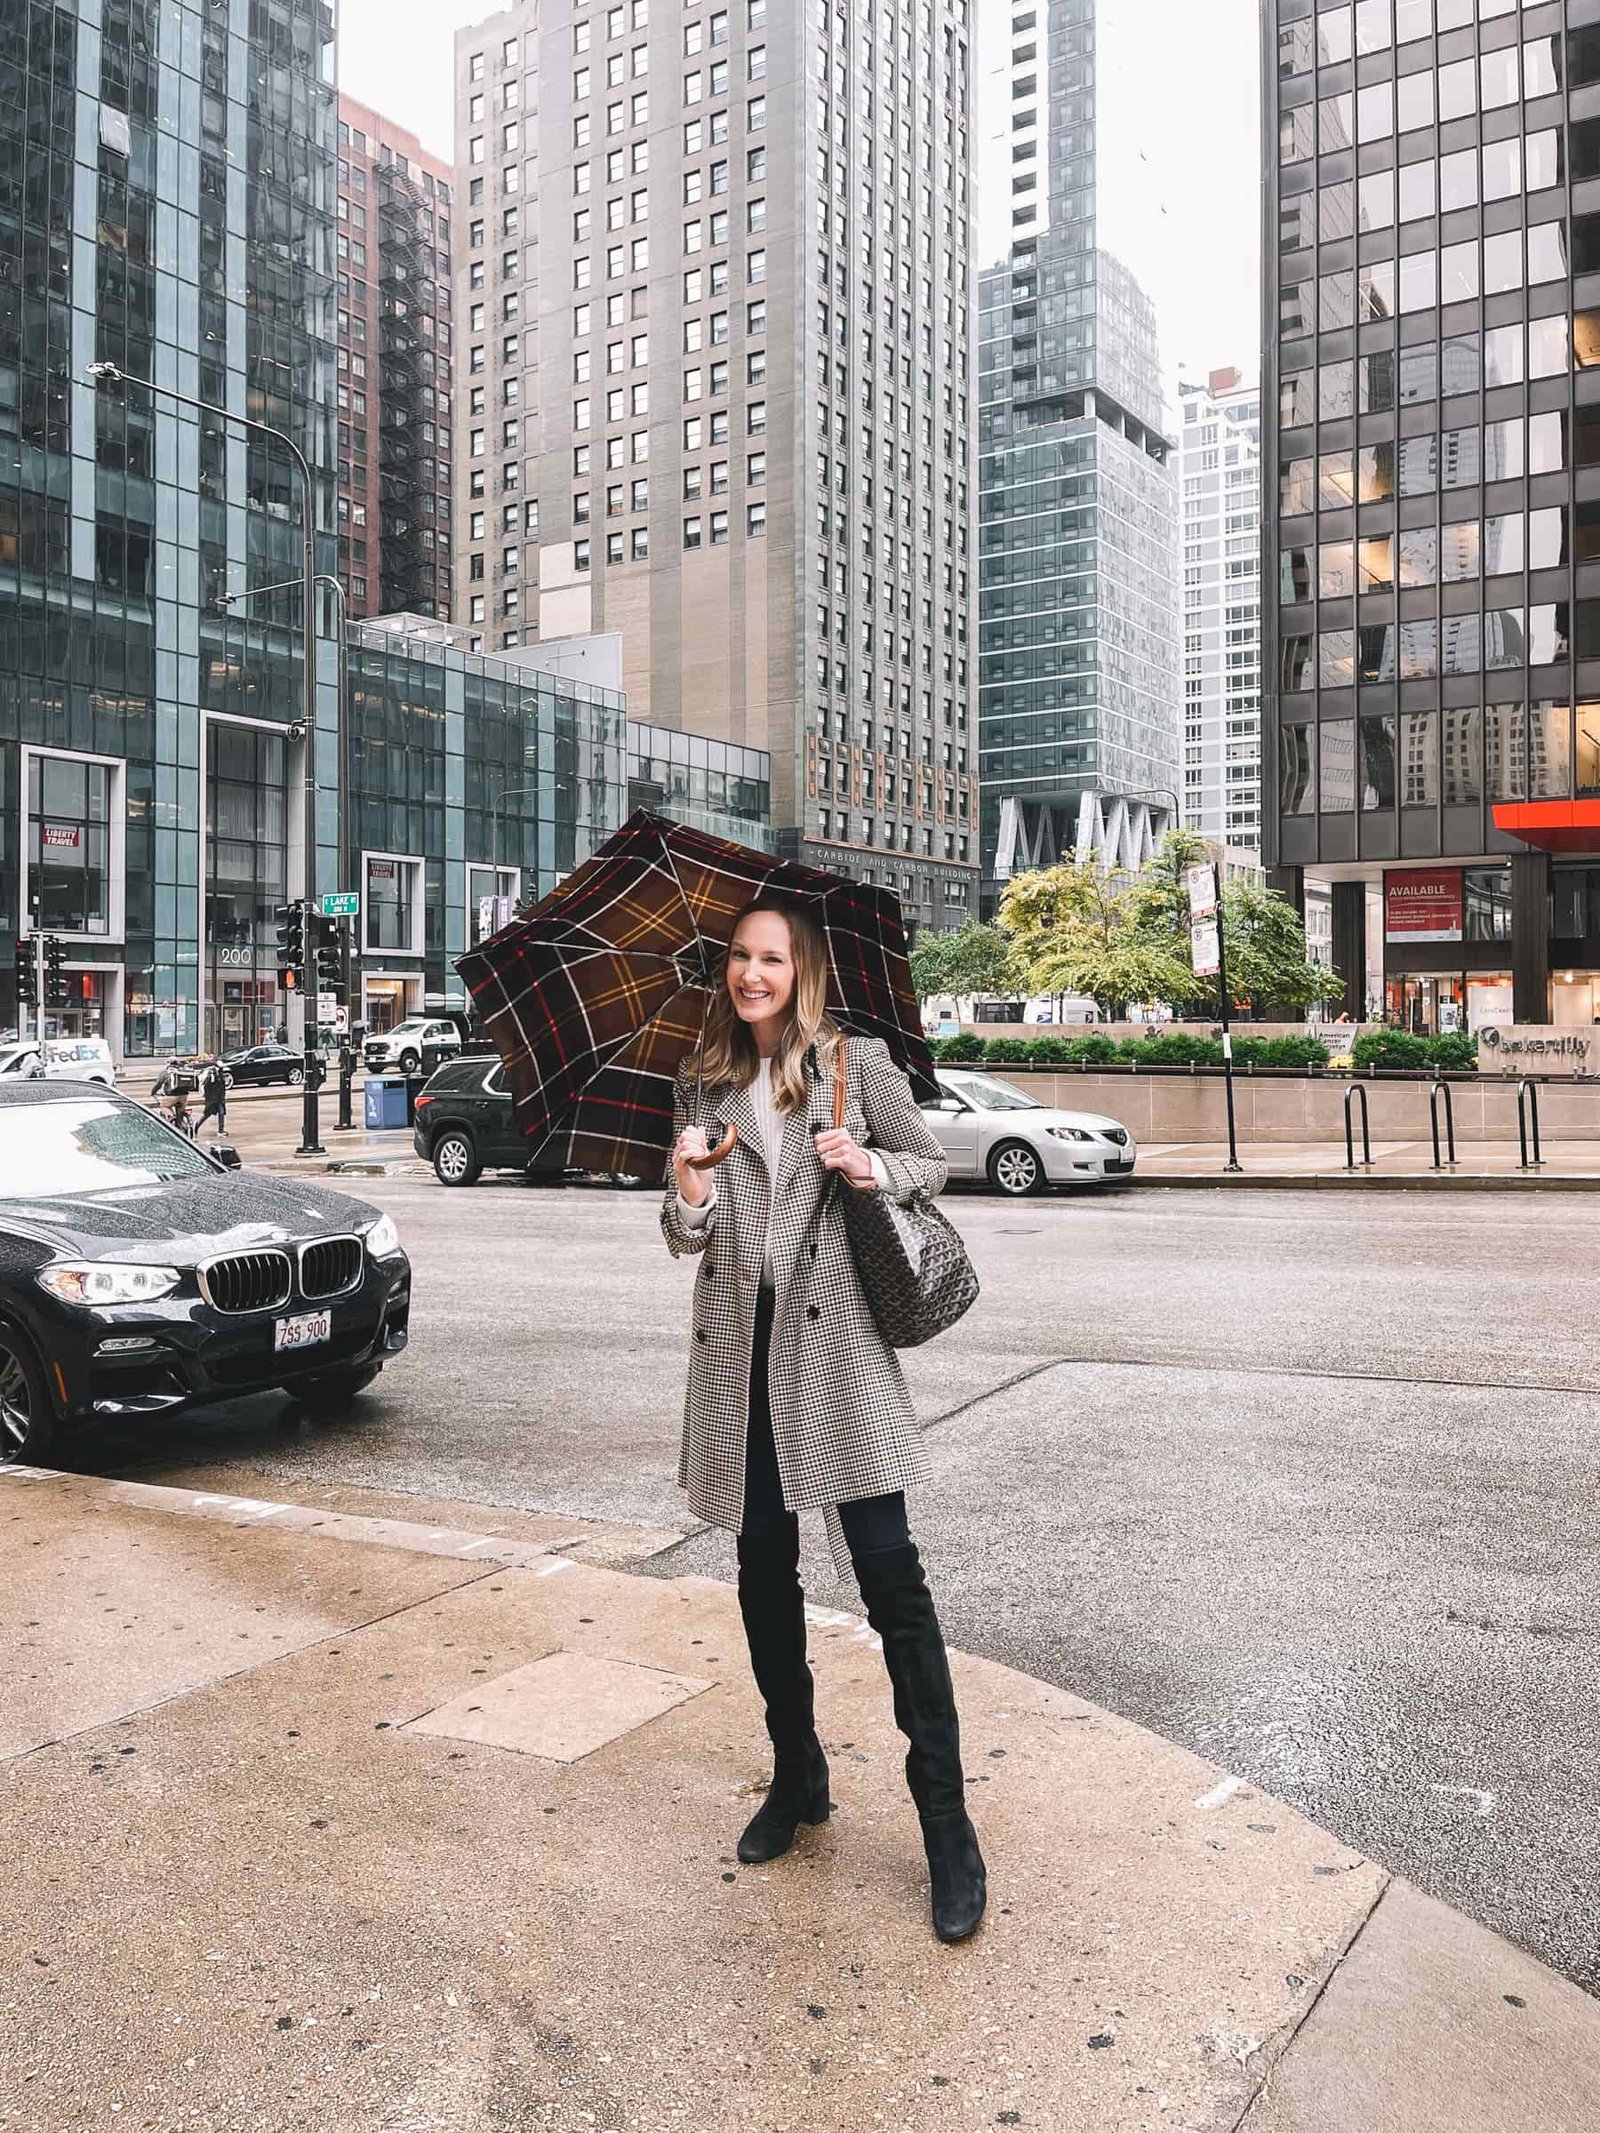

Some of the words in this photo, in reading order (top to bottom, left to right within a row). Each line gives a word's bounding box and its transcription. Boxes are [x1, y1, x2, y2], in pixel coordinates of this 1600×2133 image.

[45, 828, 76, 840] LIBERTY
[47, 837, 74, 847] TRAVEL
[817, 851, 861, 864] CARBIDE
[869, 858, 887, 867] AND
[893, 861, 928, 873] CARBON
[934, 867, 971, 880] BUILDING
[1389, 885, 1446, 897] AVAILABLE
[331, 896, 349, 906] LAKE
[221, 948, 251, 964] 200
[47, 1045, 101, 1063] FedEx
[307, 1319, 327, 1341] 900
